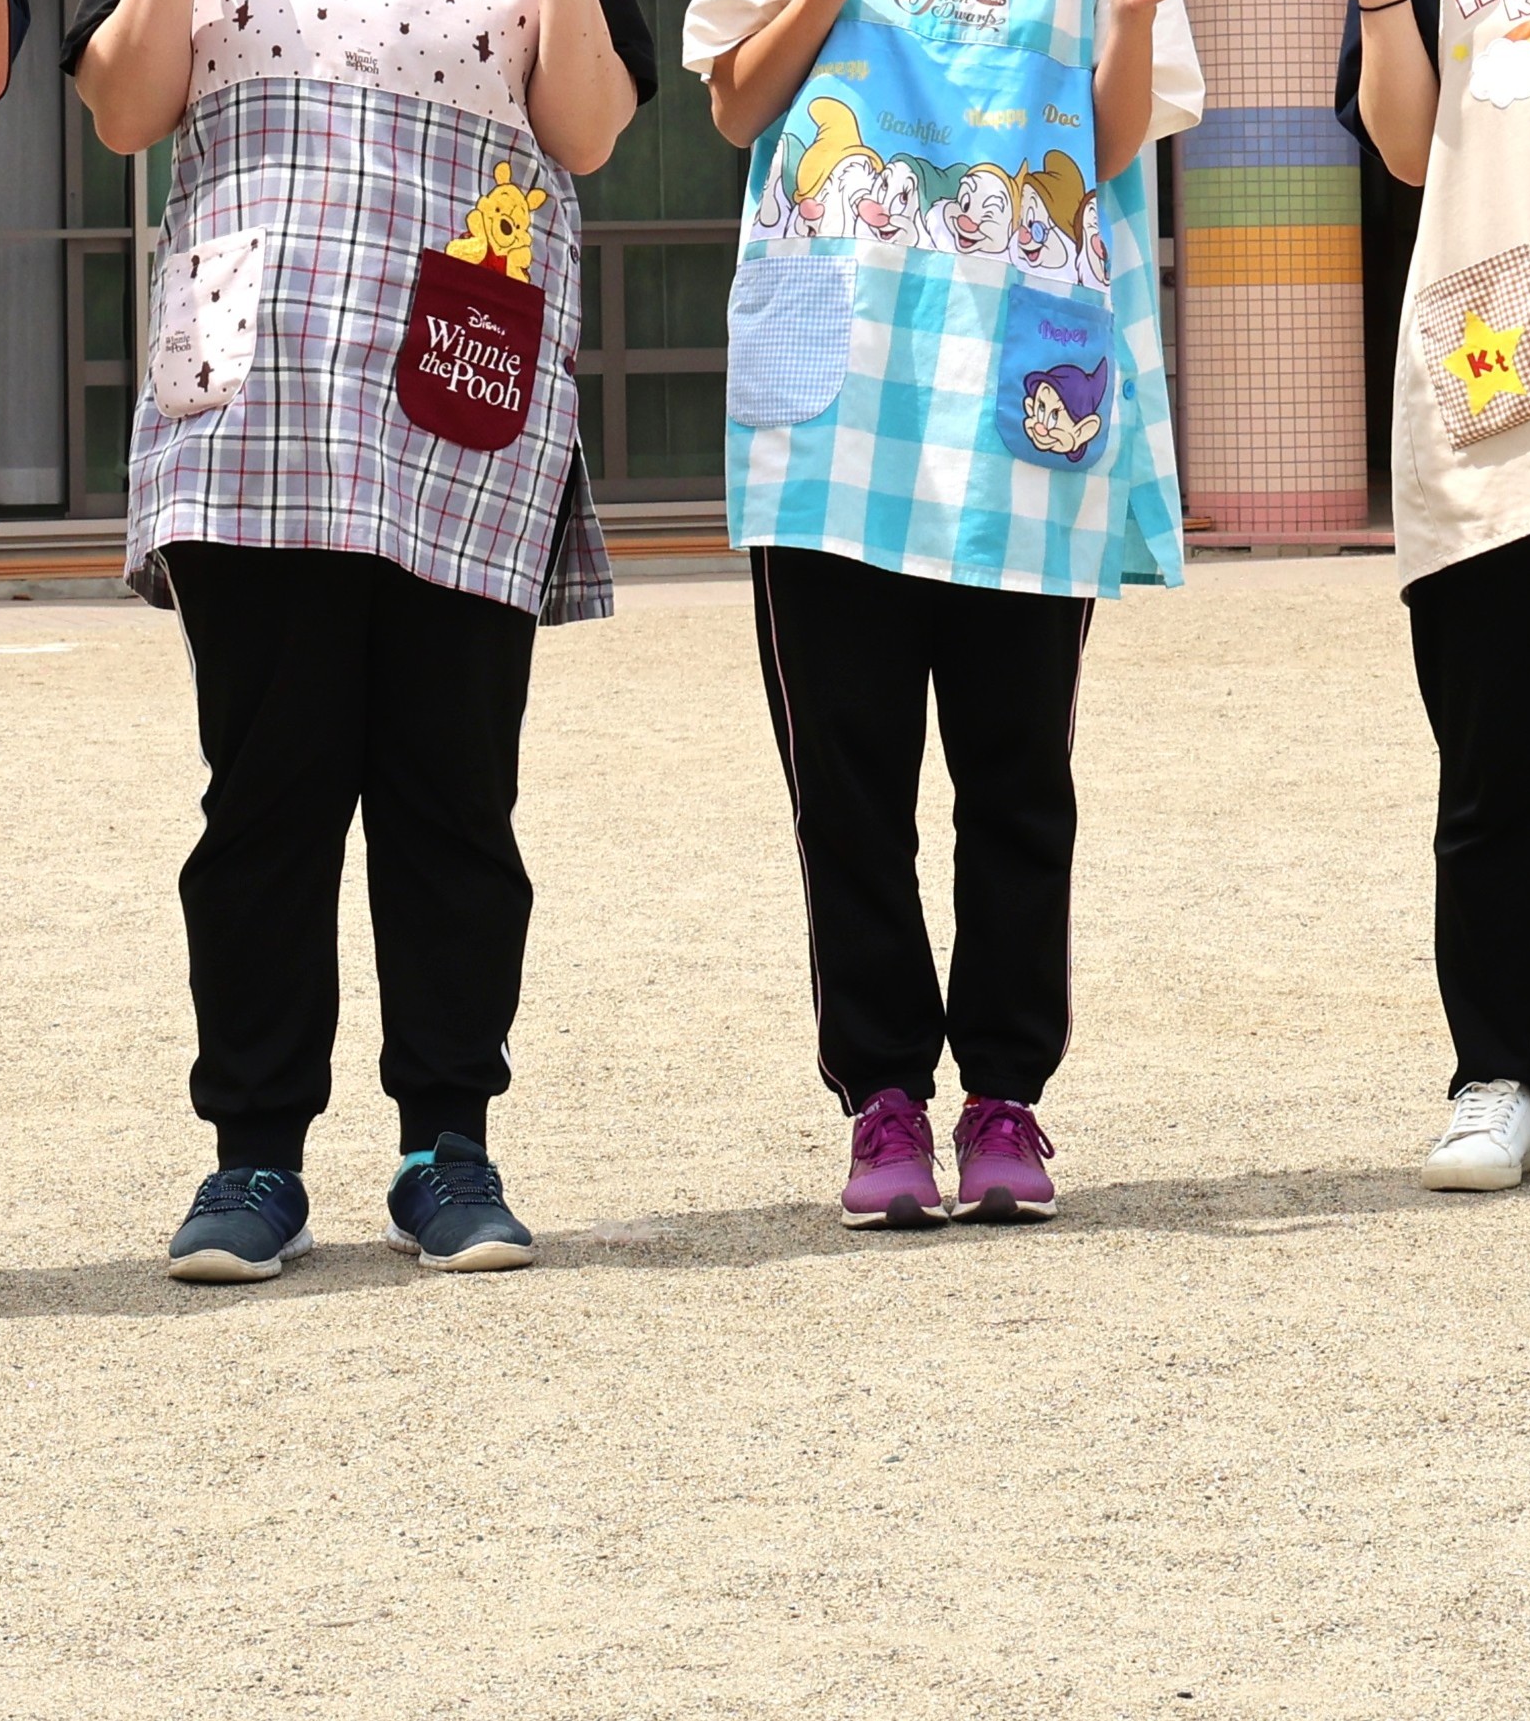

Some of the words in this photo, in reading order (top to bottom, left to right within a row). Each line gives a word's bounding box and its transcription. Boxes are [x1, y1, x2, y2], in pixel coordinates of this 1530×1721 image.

[877, 110, 952, 146] Bashful
[1042, 103, 1081, 128] Doc
[426, 315, 521, 376] Winnie
[446, 359, 521, 412] Pooh
